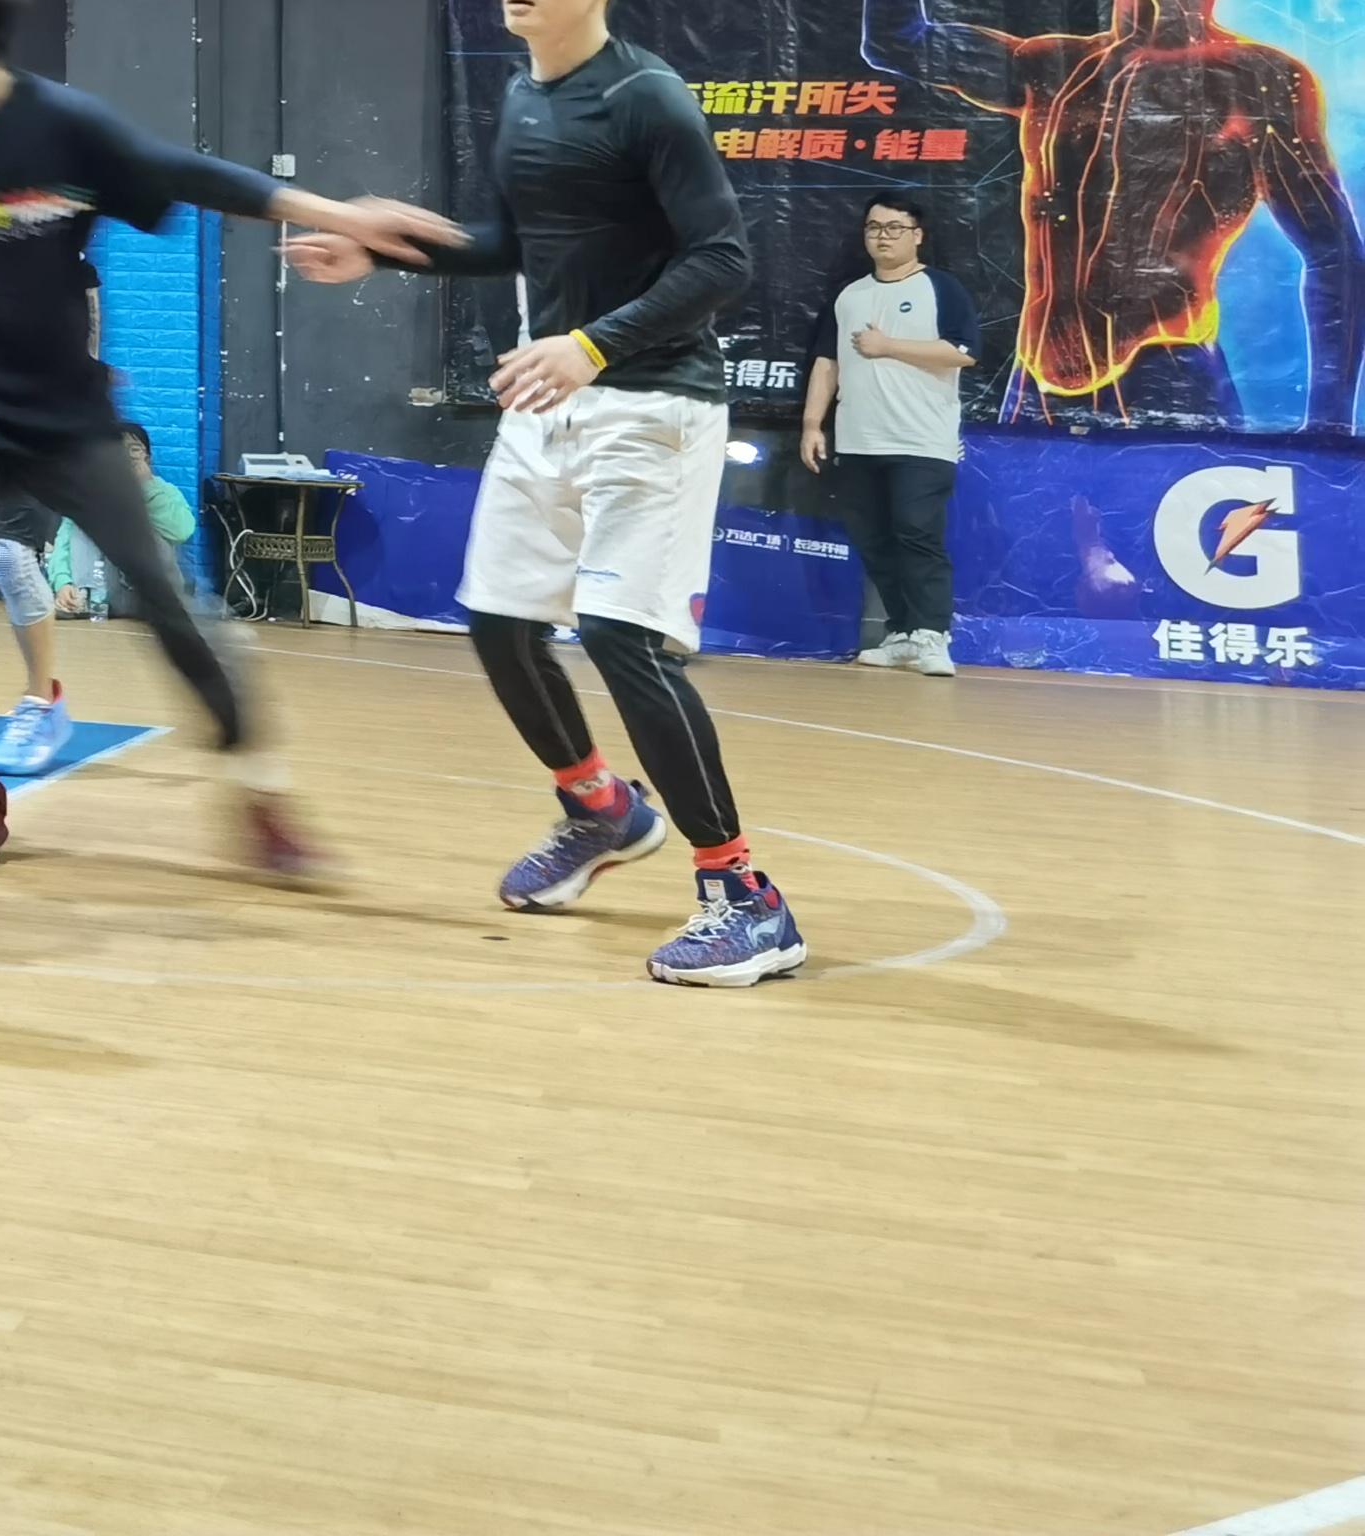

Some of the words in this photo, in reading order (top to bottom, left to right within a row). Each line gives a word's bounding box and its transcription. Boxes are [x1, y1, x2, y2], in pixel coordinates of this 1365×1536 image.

[726, 528, 782, 547] 万达广场
[1154, 466, 1301, 610] G
[1152, 619, 1317, 668] 佳得乐
